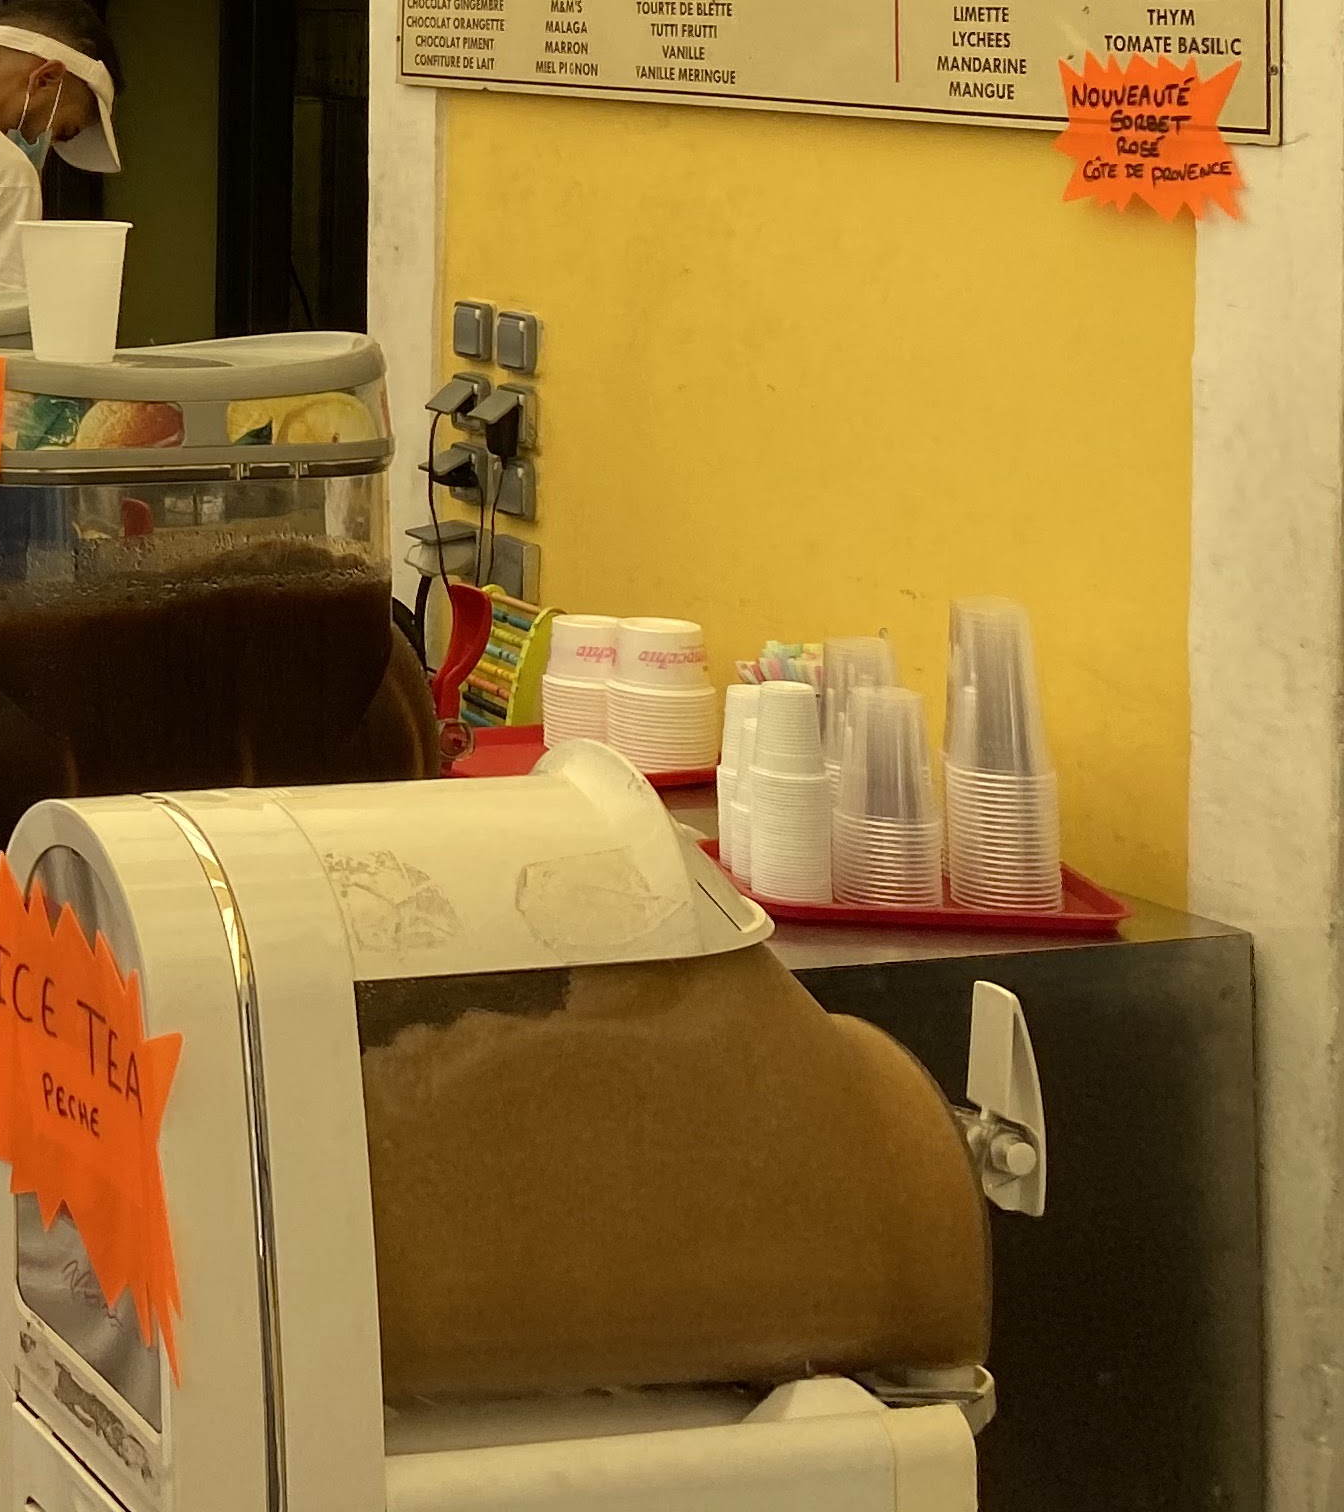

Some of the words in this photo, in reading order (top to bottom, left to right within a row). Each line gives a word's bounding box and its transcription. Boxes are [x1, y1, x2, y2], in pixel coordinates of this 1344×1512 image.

[636, 1, 677, 16] TOURTE
[679, 2, 693, 16] DE
[953, 6, 1009, 23] LIMETTE
[1147, 9, 1195, 26] THYM
[650, 23, 678, 37] TUTTI
[681, 24, 718, 39] FRUTTI
[952, 31, 1011, 48] LYCHEES
[661, 45, 705, 61] VANILLE
[1104, 34, 1172, 54] TOMATE
[1178, 38, 1242, 55] BASILIC
[936, 56, 1027, 75] MANDARINE
[678, 67, 736, 84] MERINGUE
[949, 81, 1015, 100] MANGUE
[1072, 76, 1195, 108] NOUVEAUTÉ
[1110, 109, 1192, 135] SORBET
[1125, 163, 1144, 178] DE
[76, 997, 145, 1118] TEA
